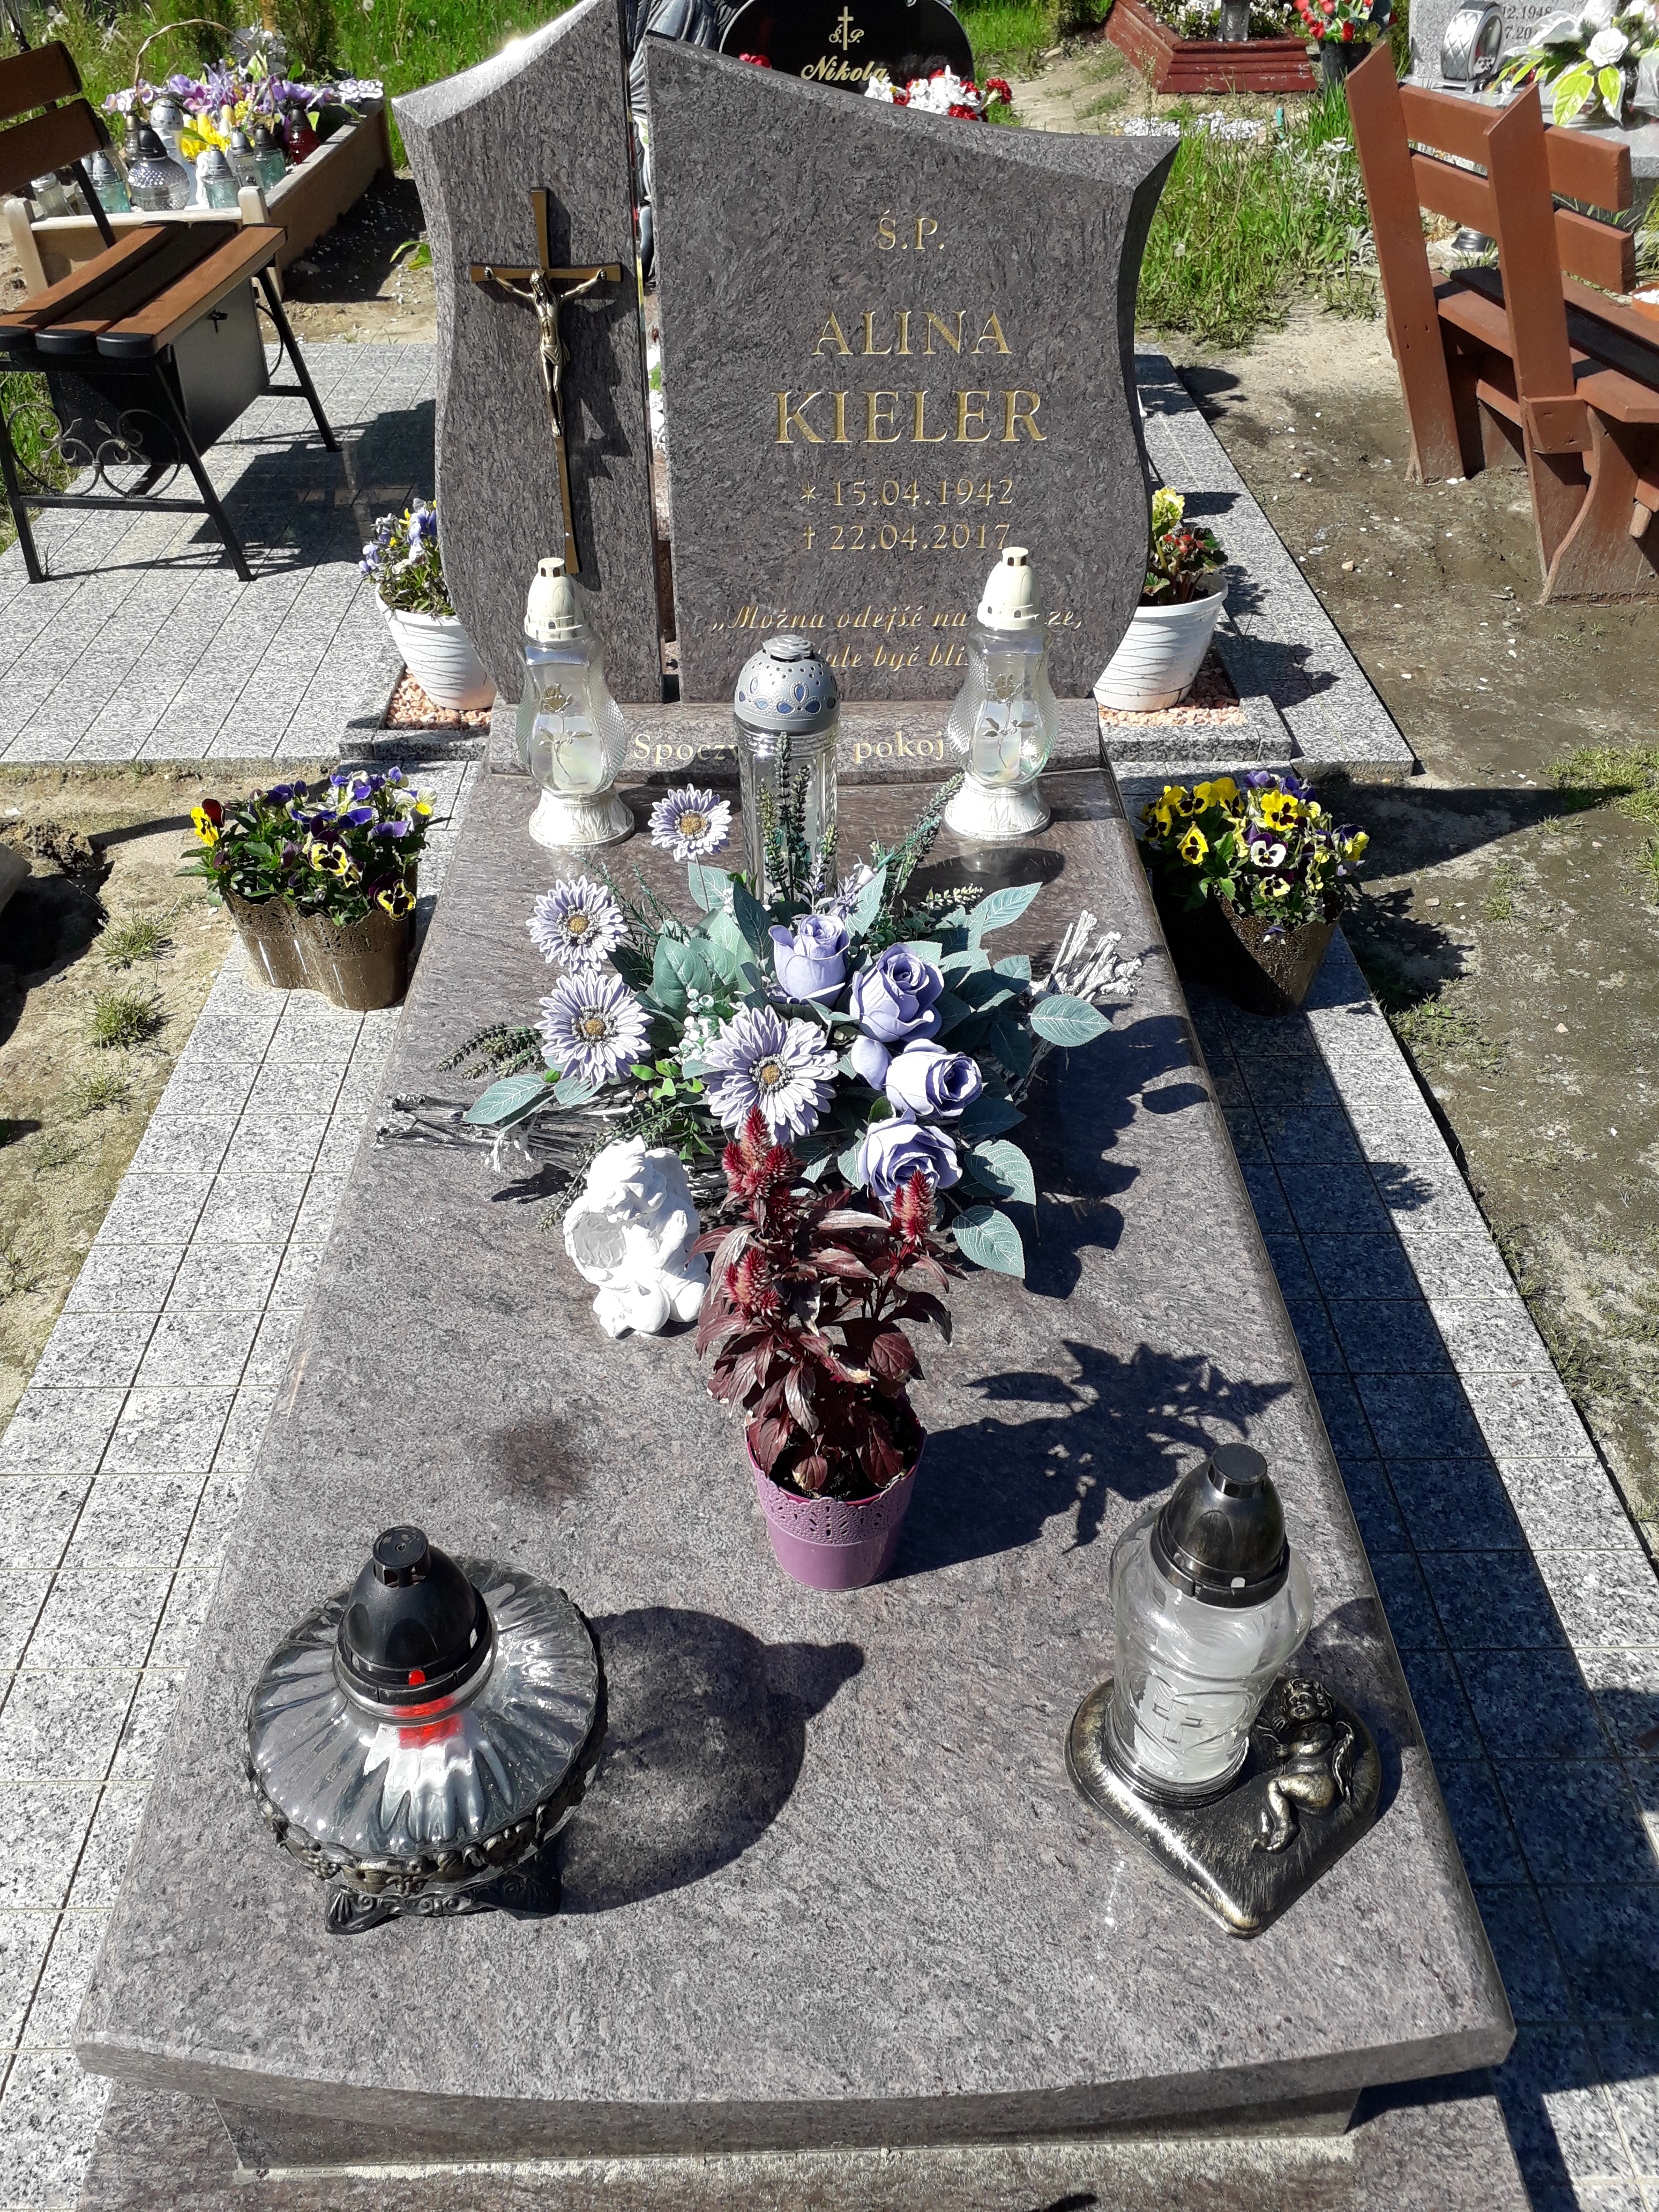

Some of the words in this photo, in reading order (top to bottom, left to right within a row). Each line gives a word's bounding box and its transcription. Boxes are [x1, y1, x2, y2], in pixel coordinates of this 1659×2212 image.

[811, 311, 1012, 355] ALINA
[770, 390, 1048, 443] KIELER
[832, 479, 1013, 506] 15.04.1942
[829, 523, 1011, 551] 22.04.2017
[836, 606, 923, 633] odejść
[931, 611, 968, 626] na
[873, 645, 921, 671] być
[854, 731, 953, 764] pokoj
